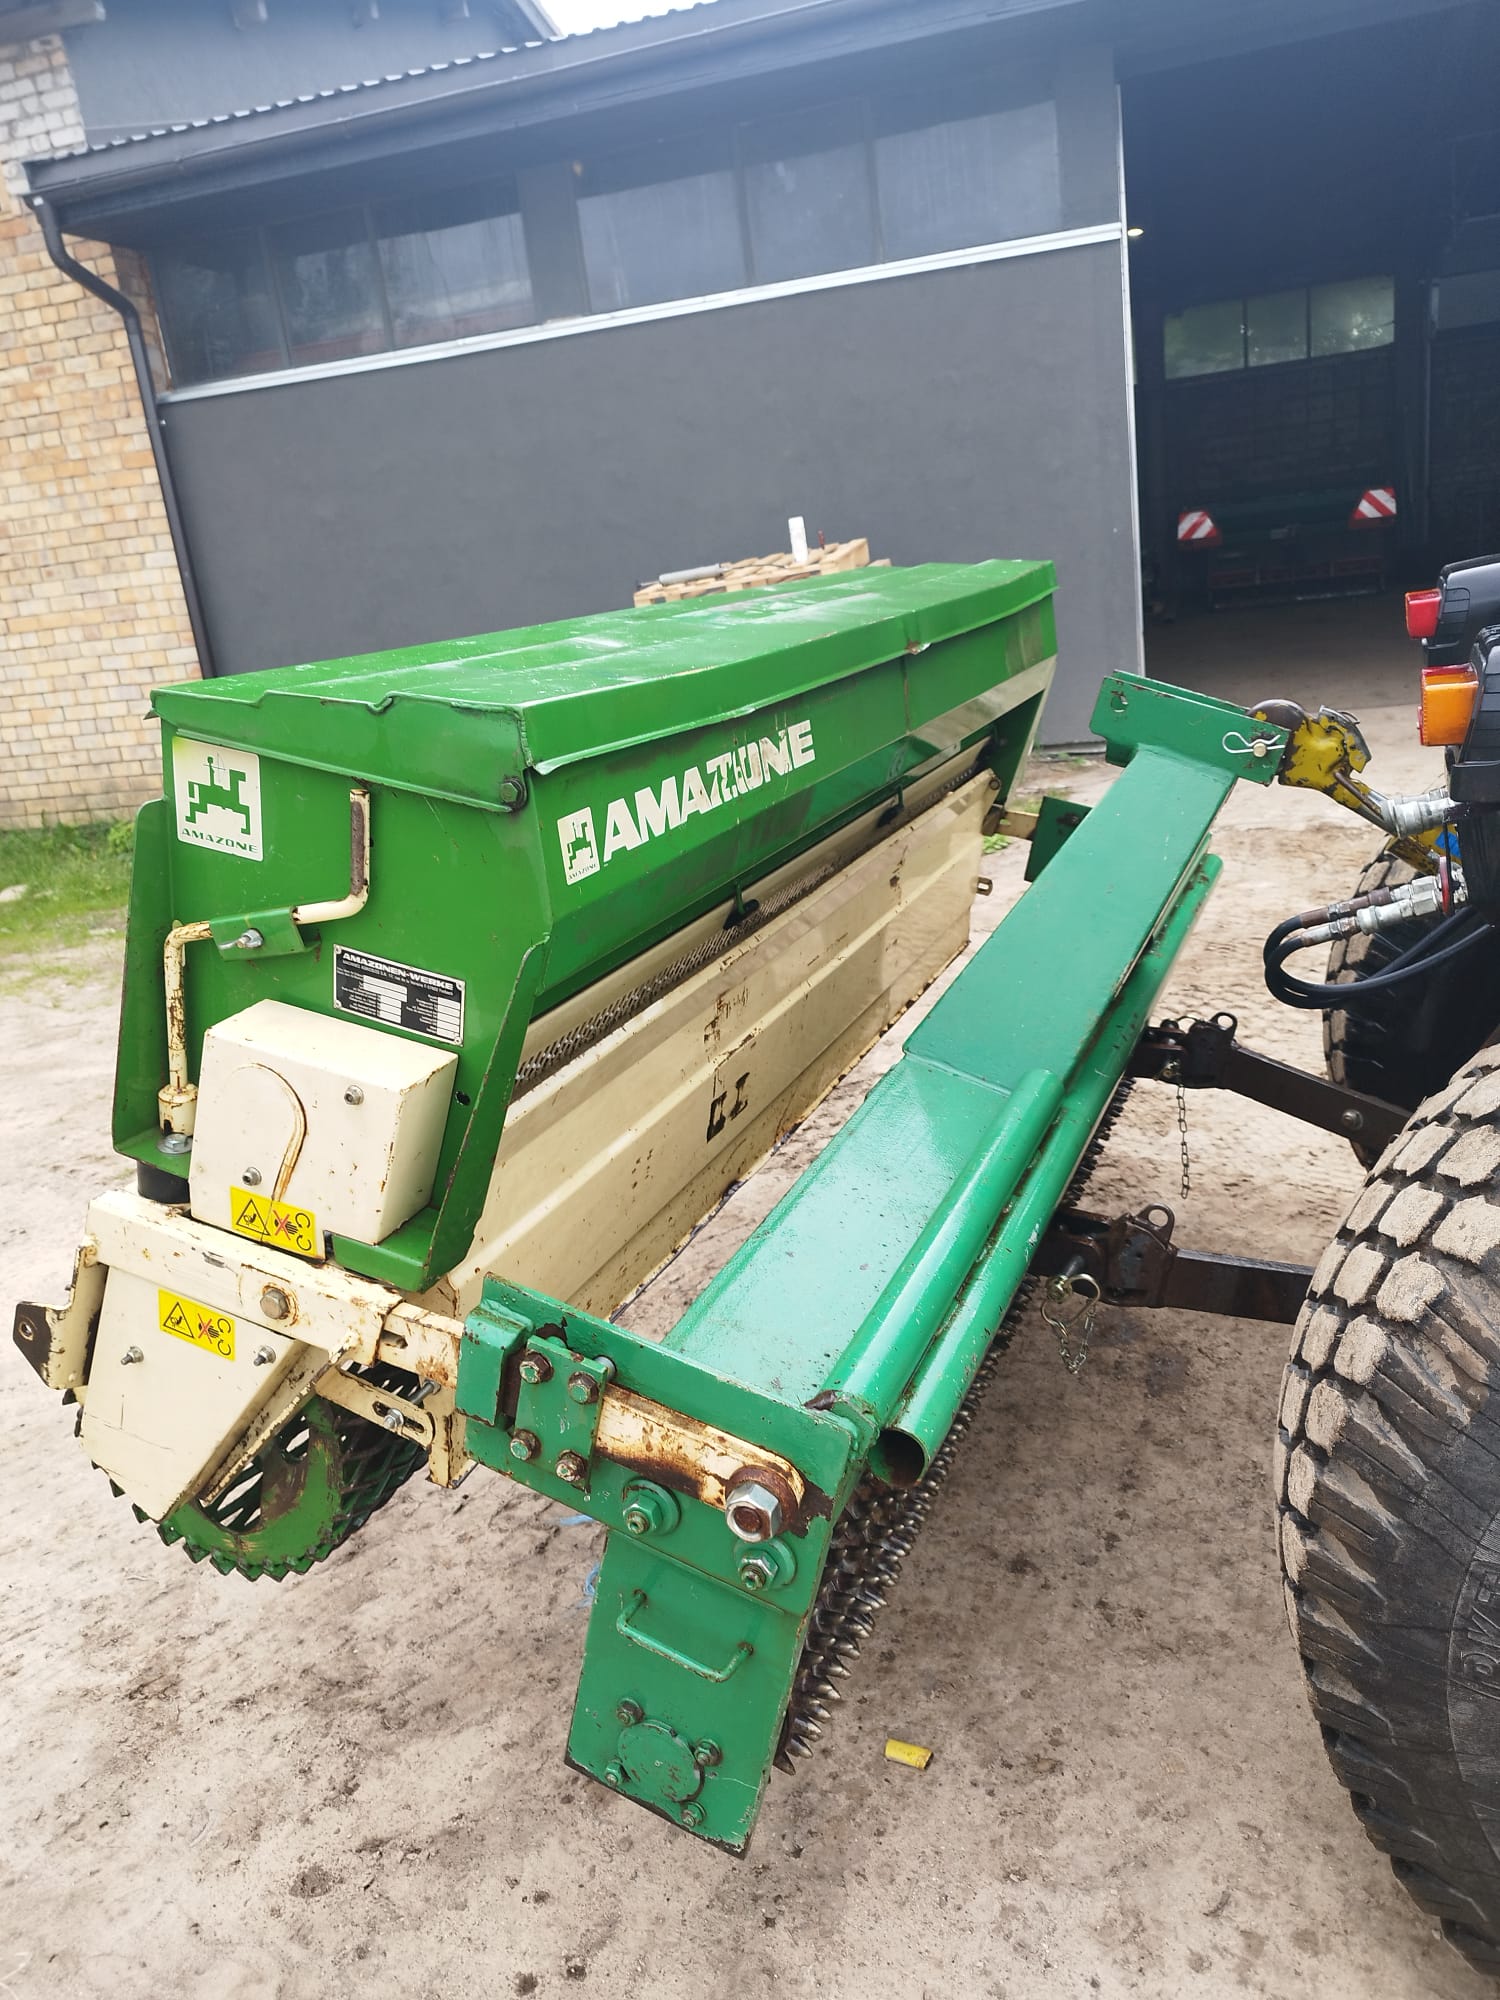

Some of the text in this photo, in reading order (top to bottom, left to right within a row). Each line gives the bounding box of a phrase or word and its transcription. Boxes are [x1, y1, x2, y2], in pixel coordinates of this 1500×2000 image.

[603, 720, 815, 862] AMAZONE
[182, 828, 258, 853] AMAZONE
[342, 952, 454, 990] AMAZONEN-WERKE
